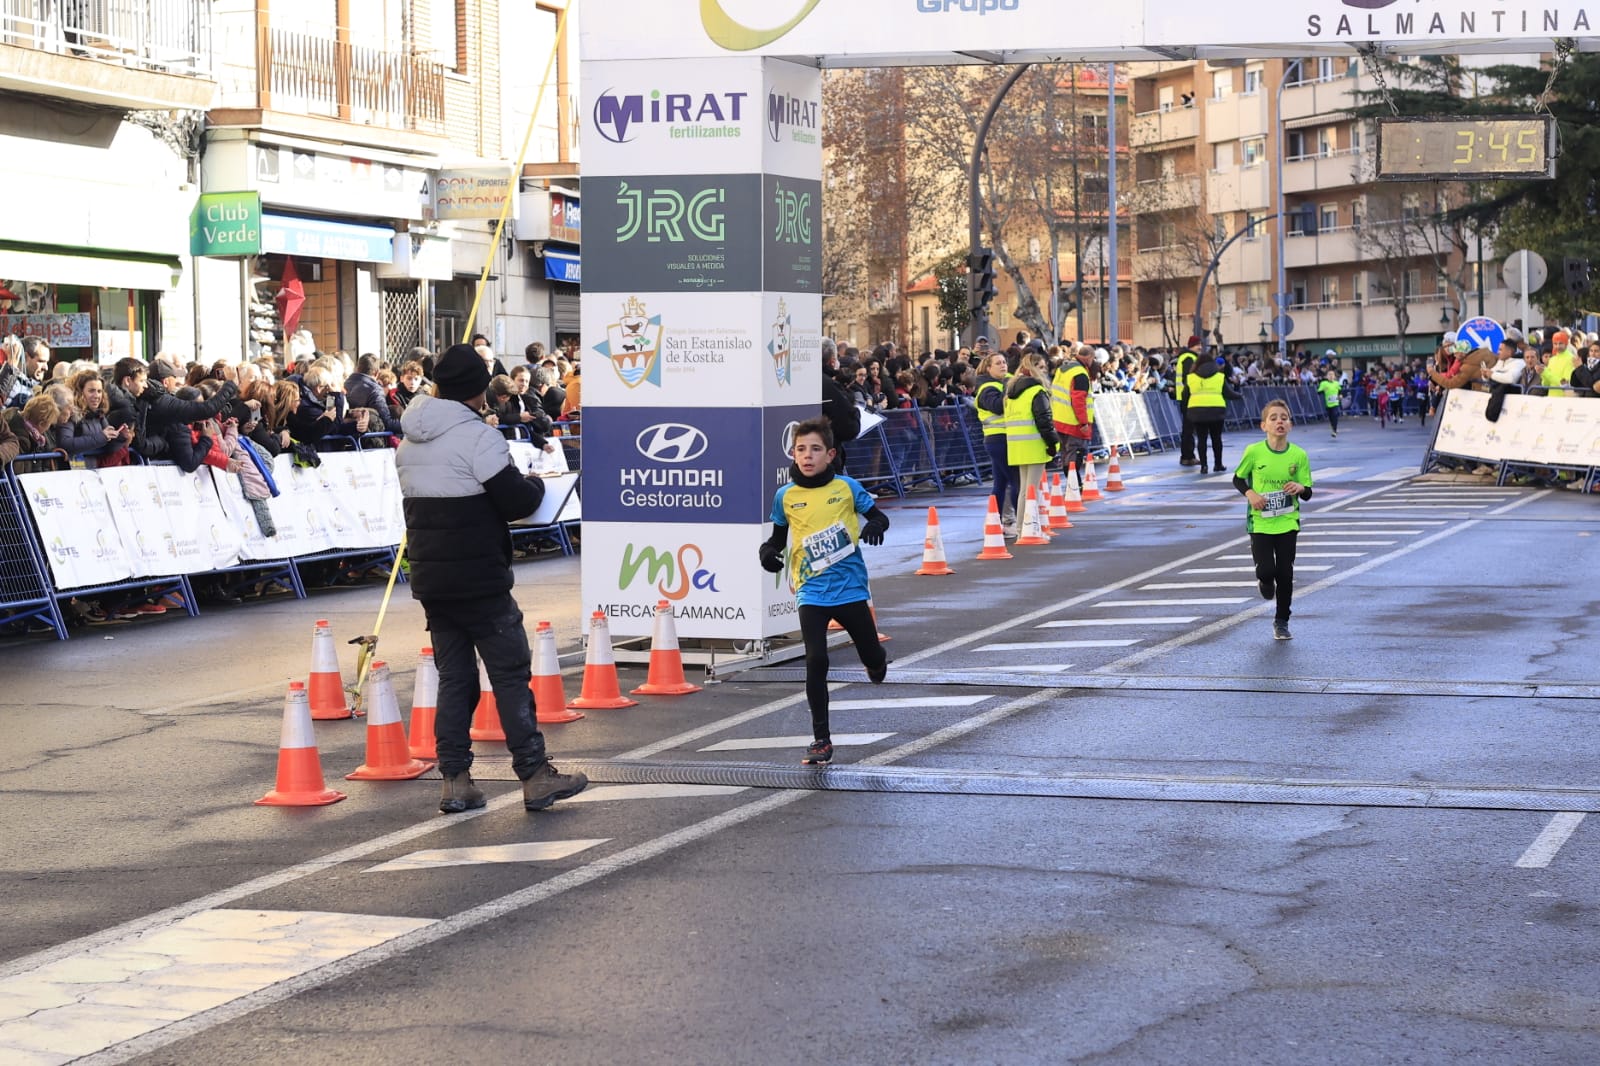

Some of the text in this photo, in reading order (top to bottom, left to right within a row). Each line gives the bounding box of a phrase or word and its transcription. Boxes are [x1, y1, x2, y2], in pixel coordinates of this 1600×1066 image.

[1307, 9, 1591, 37] SALMANTINA
[669, 125, 741, 139] fertilizantes
[1453, 130, 1538, 164] 3:45
[206, 202, 249, 223] Club
[616, 181, 725, 242] JRG
[775, 180, 811, 244] JRG
[203, 223, 257, 244] Verde
[665, 336, 753, 350] San Estanislao
[665, 350, 725, 364] de Kostka
[620, 469, 724, 487] HYUNDAI
[620, 489, 723, 508] Gestorauto
[810, 533, 840, 559] 6437
[598, 603, 746, 620] MERCASLAMANCA
